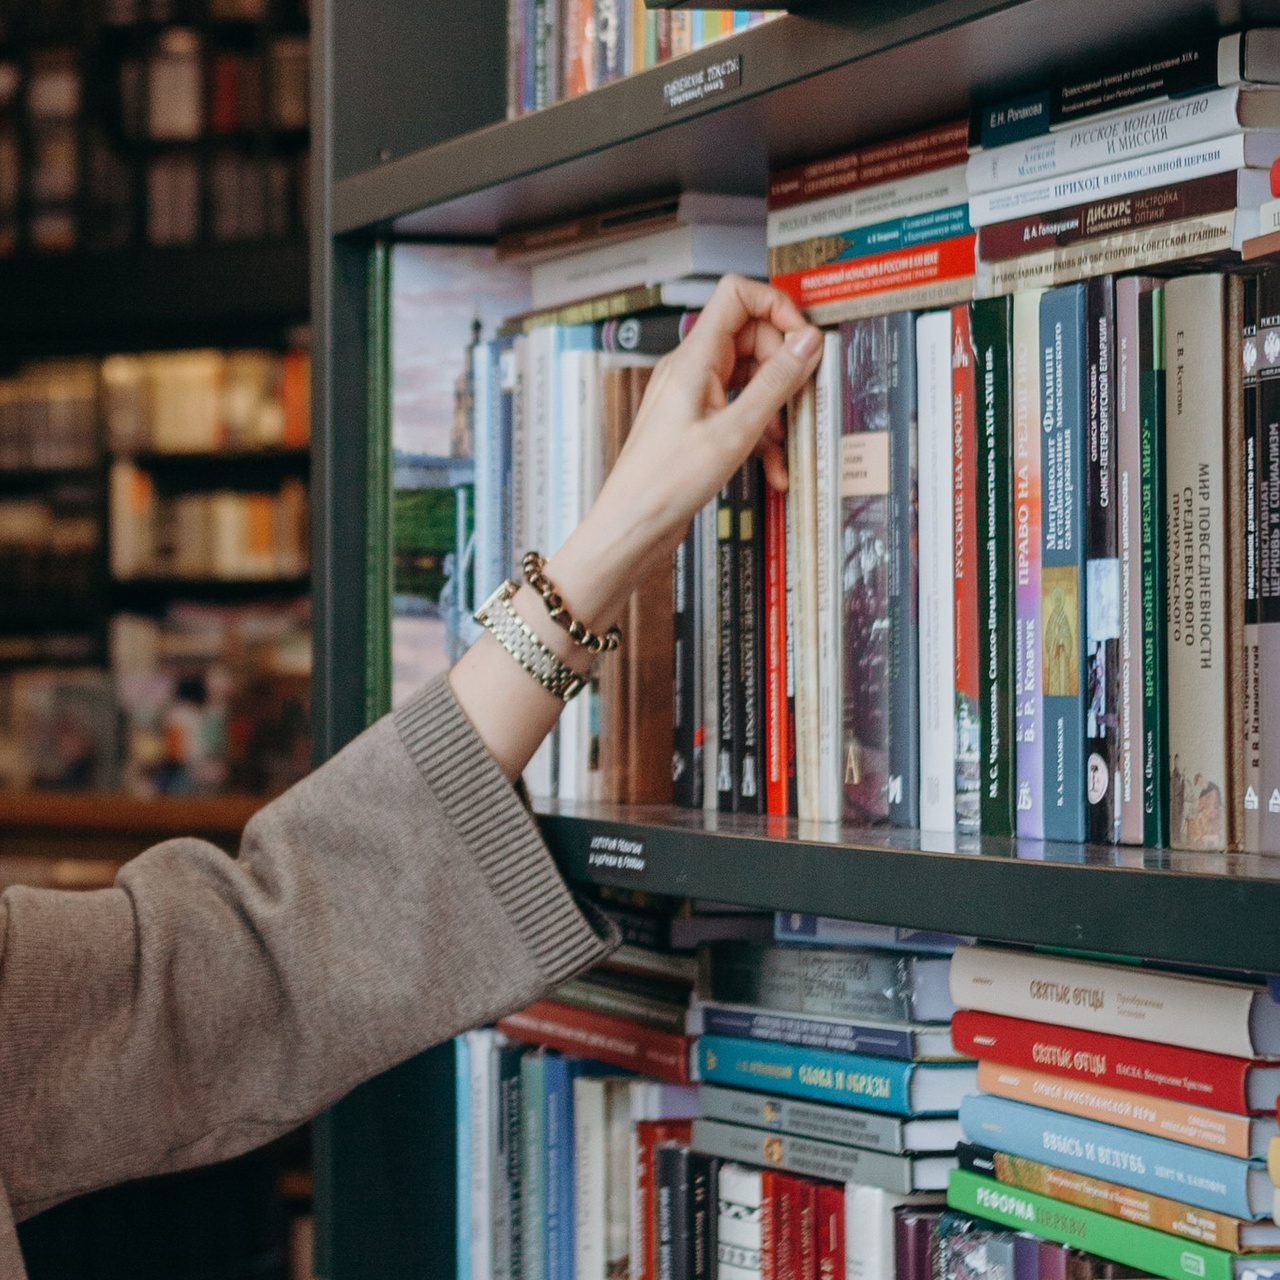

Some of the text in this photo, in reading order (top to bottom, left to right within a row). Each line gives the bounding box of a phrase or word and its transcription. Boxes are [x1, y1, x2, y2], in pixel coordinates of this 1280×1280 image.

[990, 100, 1042, 128] Е.Н. Ропакова
[1070, 97, 1209, 149] РУССКОЕ МОНАШЕСТВО
[1106, 124, 1168, 155] И МИССИЯ
[1054, 176, 1099, 197] ПРИХОД
[1111, 157, 1181, 183] ПРАВОСЛАВНОЙ
[1184, 149, 1220, 168] ЦЕРКВИ
[1134, 190, 1177, 210] НАСТРОЙКА
[1038, 216, 1078, 237] Головушкин
[1086, 199, 1130, 223] ДИСКУРС
[1134, 207, 1164, 224] ОПТИКИ
[992, 266, 1042, 284] ПРАВОСЛАВНАЯ
[1044, 259, 1076, 273] ЦЕРКОВЬ
[1078, 256, 1086, 265] ПО
[1105, 245, 1138, 260] СТОРОНЫ
[1141, 234, 1186, 252] СОВЕТСКОЙ
[1187, 226, 1227, 243] ГРАНИЦЫ
[1176, 330, 1183, 343] Е.
[1176, 348, 1183, 360] В.
[1054, 322, 1063, 428] московского
[1098, 315, 1109, 508] САНКТ-ПЕТЕРБУРГСКОЙ ЕПАРХИИ
[954, 392, 963, 579] РУССКИЕ НА АФОНЕ
[1015, 342, 1029, 586] ПРАВО НА РЕЛИГИЮ
[1055, 431, 1063, 536] становление
[1063, 427, 1072, 550] самодержавия
[1046, 437, 1056, 550] Митрополит
[1269, 422, 1280, 597] ЦЕРКОВЬ И СОЦИАЛИЗМ
[1143, 416, 1154, 707] «ВРЕМЯ ВОЙНЕ И ВРЕМЯ МИРУ»
[1182, 485, 1194, 647] СРЕДНЕВЕКОВОГО
[1197, 461, 1212, 670] МИР ПОВСЕДНЕВНОСТИ
[1261, 480, 1269, 597] ПРАВОСЛАВНАЯ
[1170, 492, 1182, 643] ПРИУРАЛЬСКОГО
[1122, 561, 1130, 658] ХРИСТИАНСКИЙ
[721, 627, 732, 741] ПАТРИАРХИ
[744, 630, 754, 746] ПАТРИАРХИ
[1122, 751, 1130, 802] РОССИИ
[1029, 980, 1105, 1010] СВЯТЫЕ ОТЦЫ
[798, 1066, 834, 1087] СЛОВА
[835, 1070, 845, 1090] И
[846, 1072, 891, 1099] ОБРАЗЫ
[1032, 1042, 1106, 1076] СВЯТЫЕ ОТЦЫ
[1031, 1080, 1157, 1124] СМЫСЛ ХРИСТИАНСКОЙ ВЕРЫ
[1042, 1131, 1146, 1175] ВВЫСЬ И ВГЛУБЬ
[976, 1187, 1035, 1222] РЕФОРМА
[1036, 1210, 1088, 1238] ЦЕРКВИ
